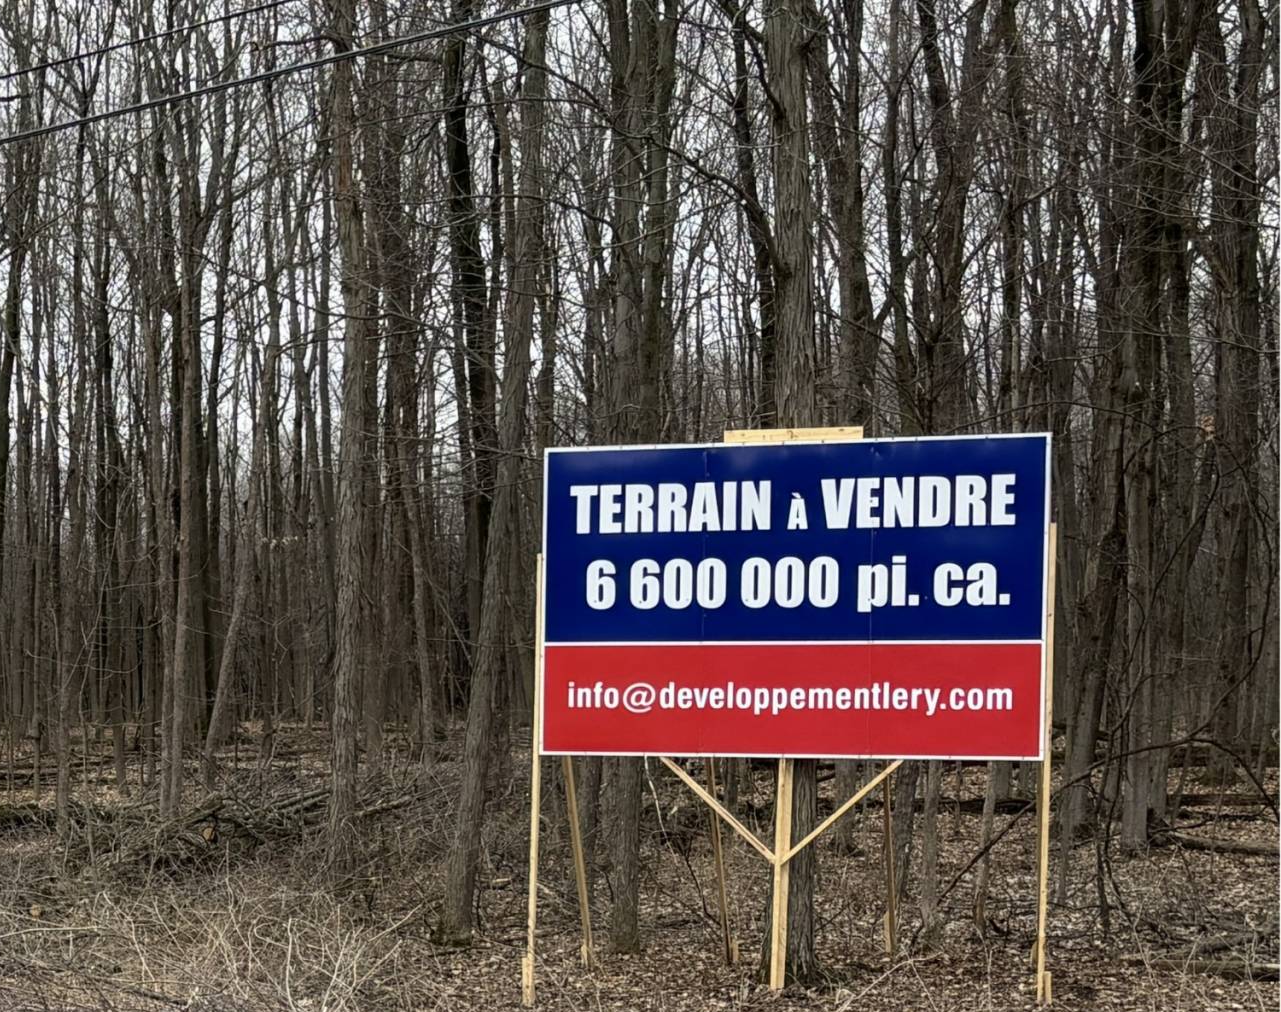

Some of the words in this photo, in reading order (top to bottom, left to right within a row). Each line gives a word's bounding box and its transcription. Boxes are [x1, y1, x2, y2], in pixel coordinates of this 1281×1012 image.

[570, 480, 772, 534] TERRAIN
[787, 492, 808, 530] À
[821, 474, 1016, 529] VENDRE
[586, 560, 616, 609] 6
[630, 558, 726, 609] 600
[741, 556, 839, 608] 000
[857, 555, 920, 613] pi.
[933, 562, 1011, 606] ca.
[567, 681, 1013, 715] info@developpementlery.com
